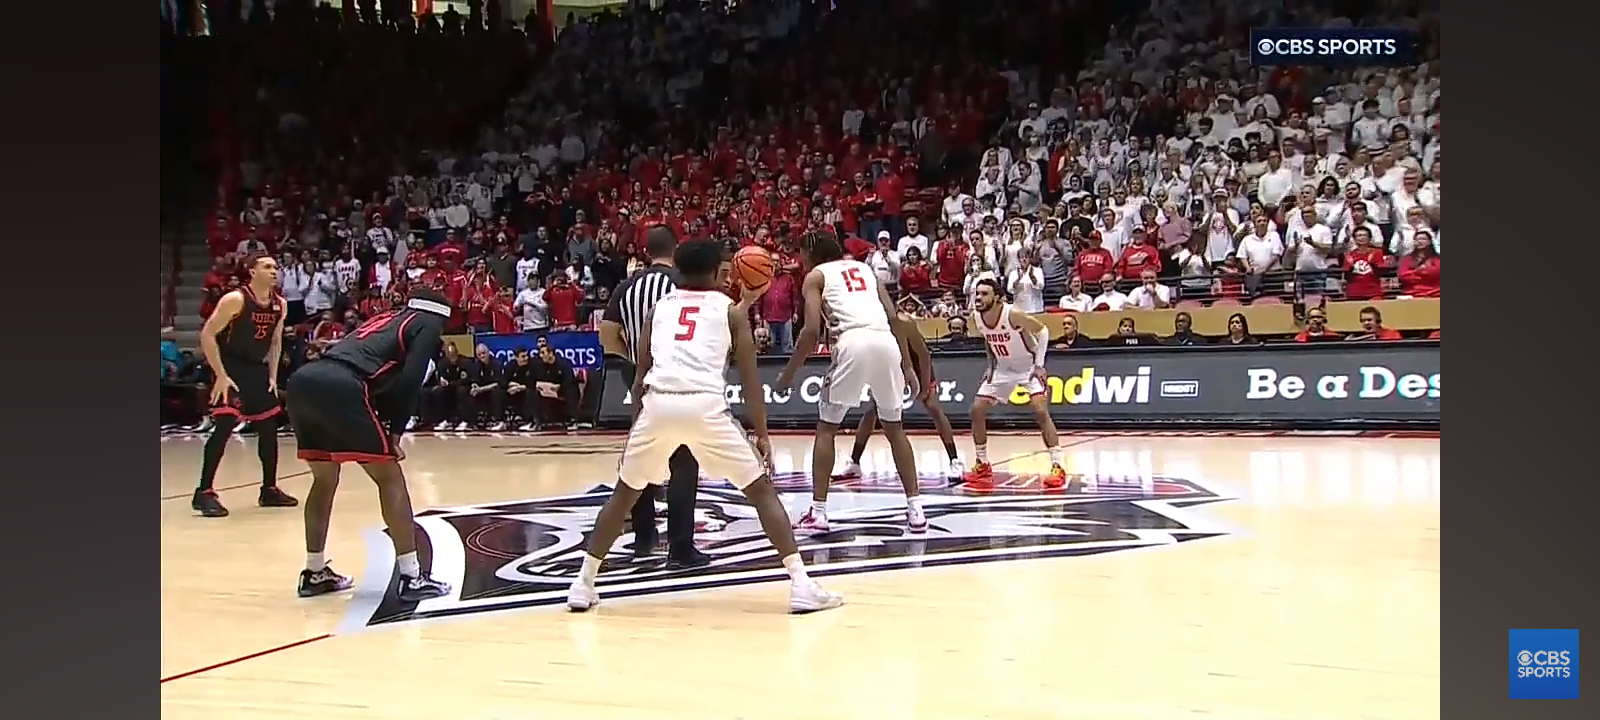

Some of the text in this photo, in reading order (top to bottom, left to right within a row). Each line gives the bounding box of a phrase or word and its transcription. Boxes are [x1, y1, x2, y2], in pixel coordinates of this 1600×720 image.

[841, 267, 867, 292] 15
[254, 325, 268, 339] 25
[674, 306, 700, 341] 5
[994, 344, 1009, 356] 10
[1246, 368, 1306, 399] Be
[1317, 375, 1349, 399] a
